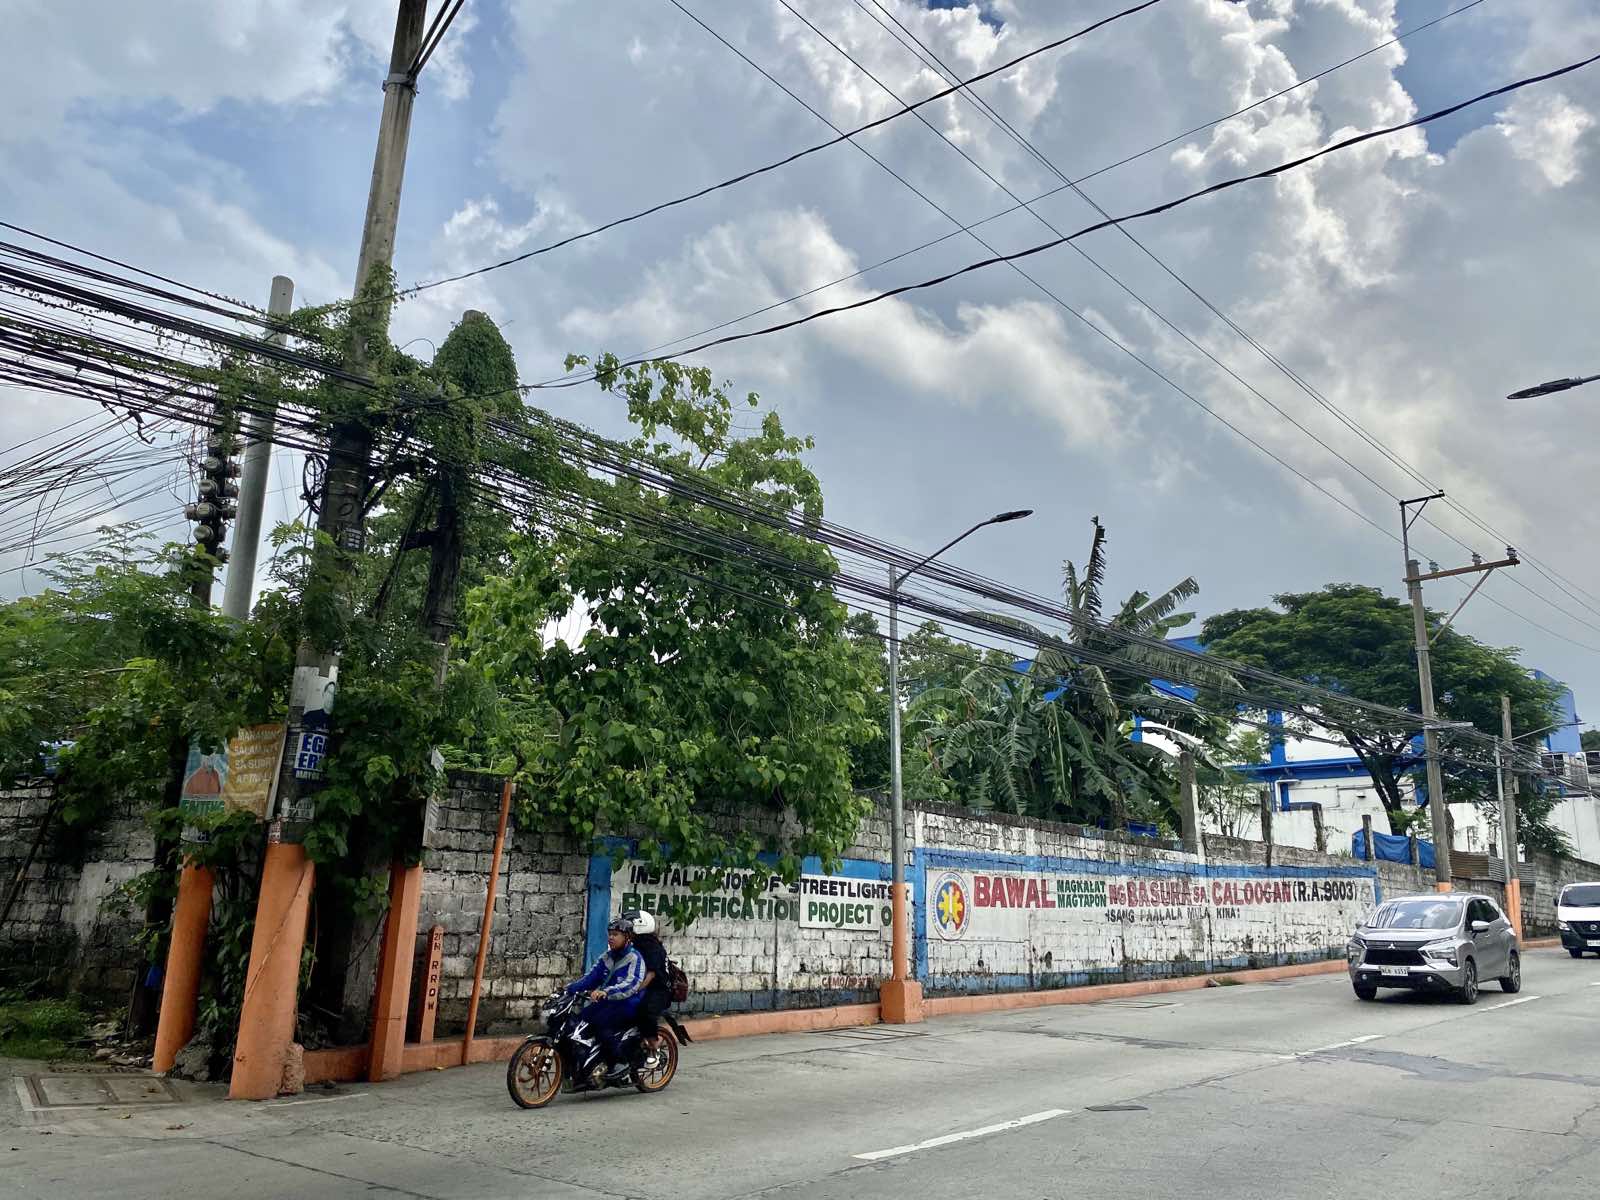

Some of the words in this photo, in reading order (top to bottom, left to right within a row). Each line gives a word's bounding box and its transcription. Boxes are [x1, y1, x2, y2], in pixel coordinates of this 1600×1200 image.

[974, 875, 1056, 909] BAWAL
[1056, 879, 1106, 893] MAGKALAT
[1109, 884, 1126, 905] NG
[1057, 893, 1107, 908] MAGTAPON
[808, 901, 874, 928] PROJECT
